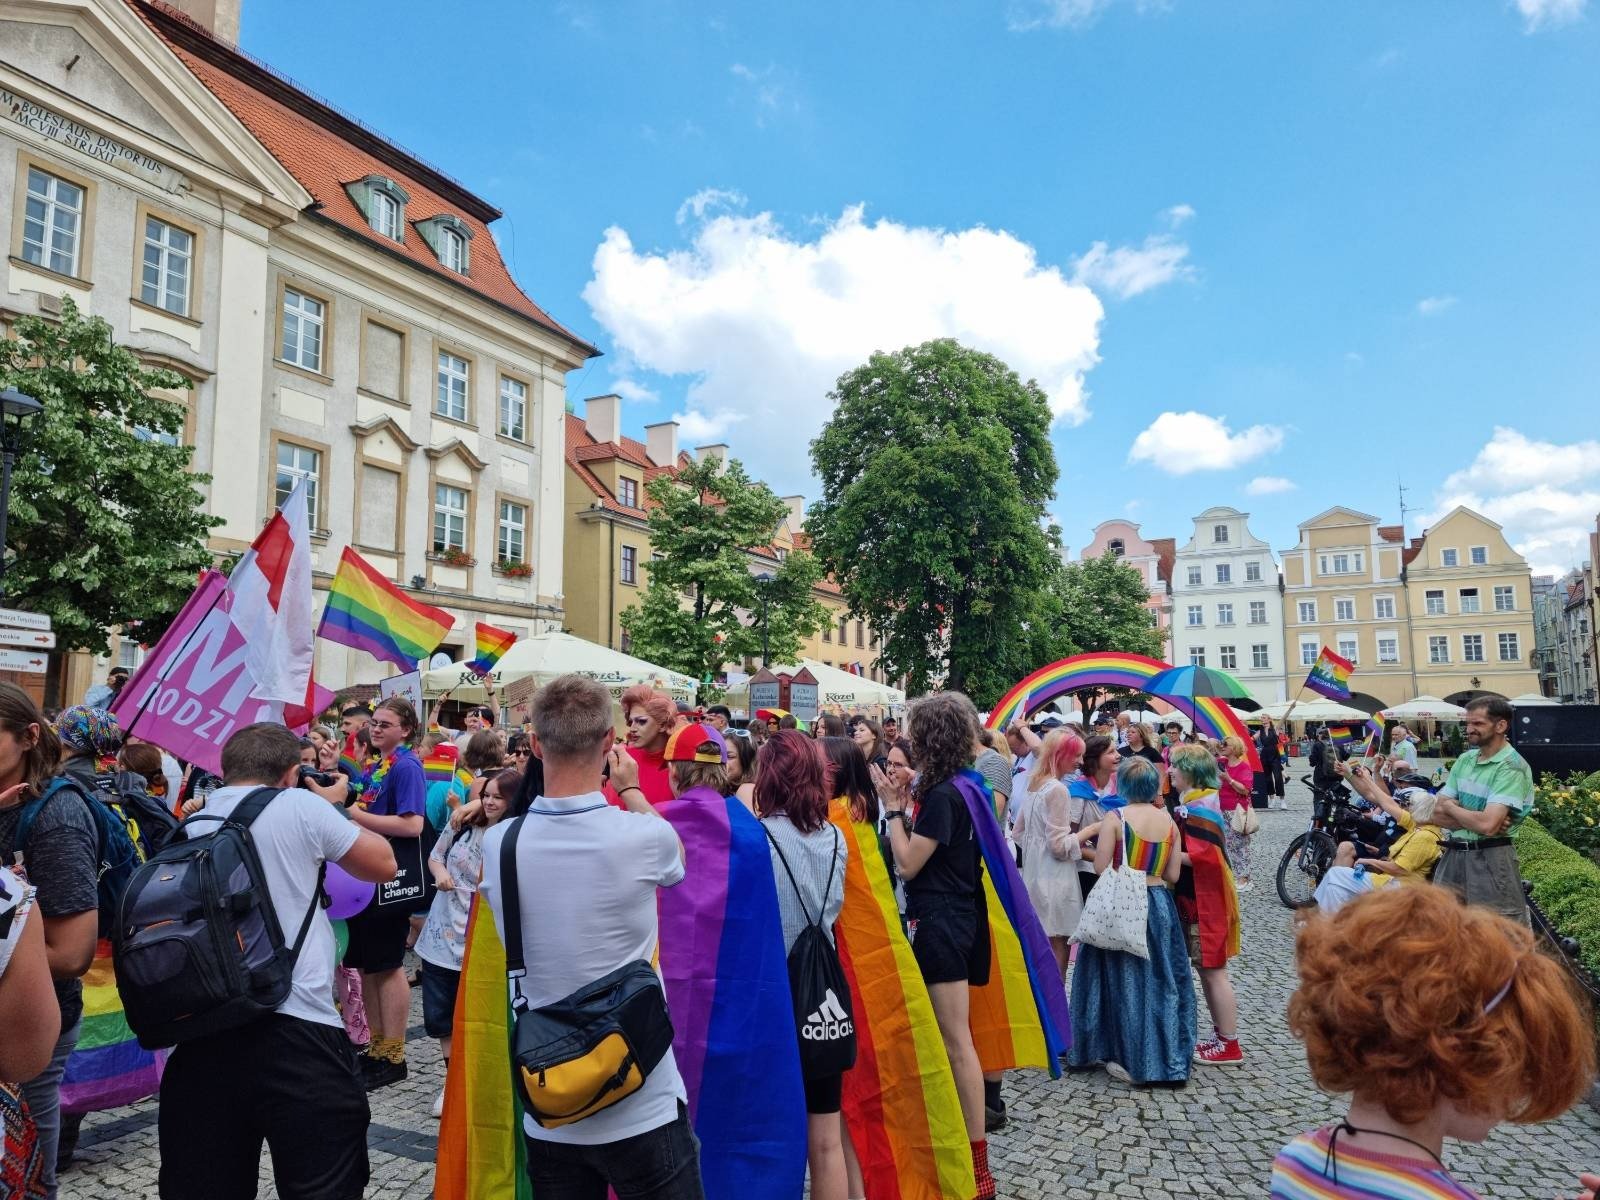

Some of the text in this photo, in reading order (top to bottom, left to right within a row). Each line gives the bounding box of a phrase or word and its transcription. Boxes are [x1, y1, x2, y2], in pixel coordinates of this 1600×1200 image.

[15, 112, 117, 164] MCVIII STRUXIT
[21, 101, 92, 142] BOLESLAUS
[96, 137, 163, 174] DISTORTUS
[825, 692, 855, 703] Kozel
[383, 880, 400, 890] the
[384, 886, 420, 899] change
[802, 1020, 854, 1041] adidas
